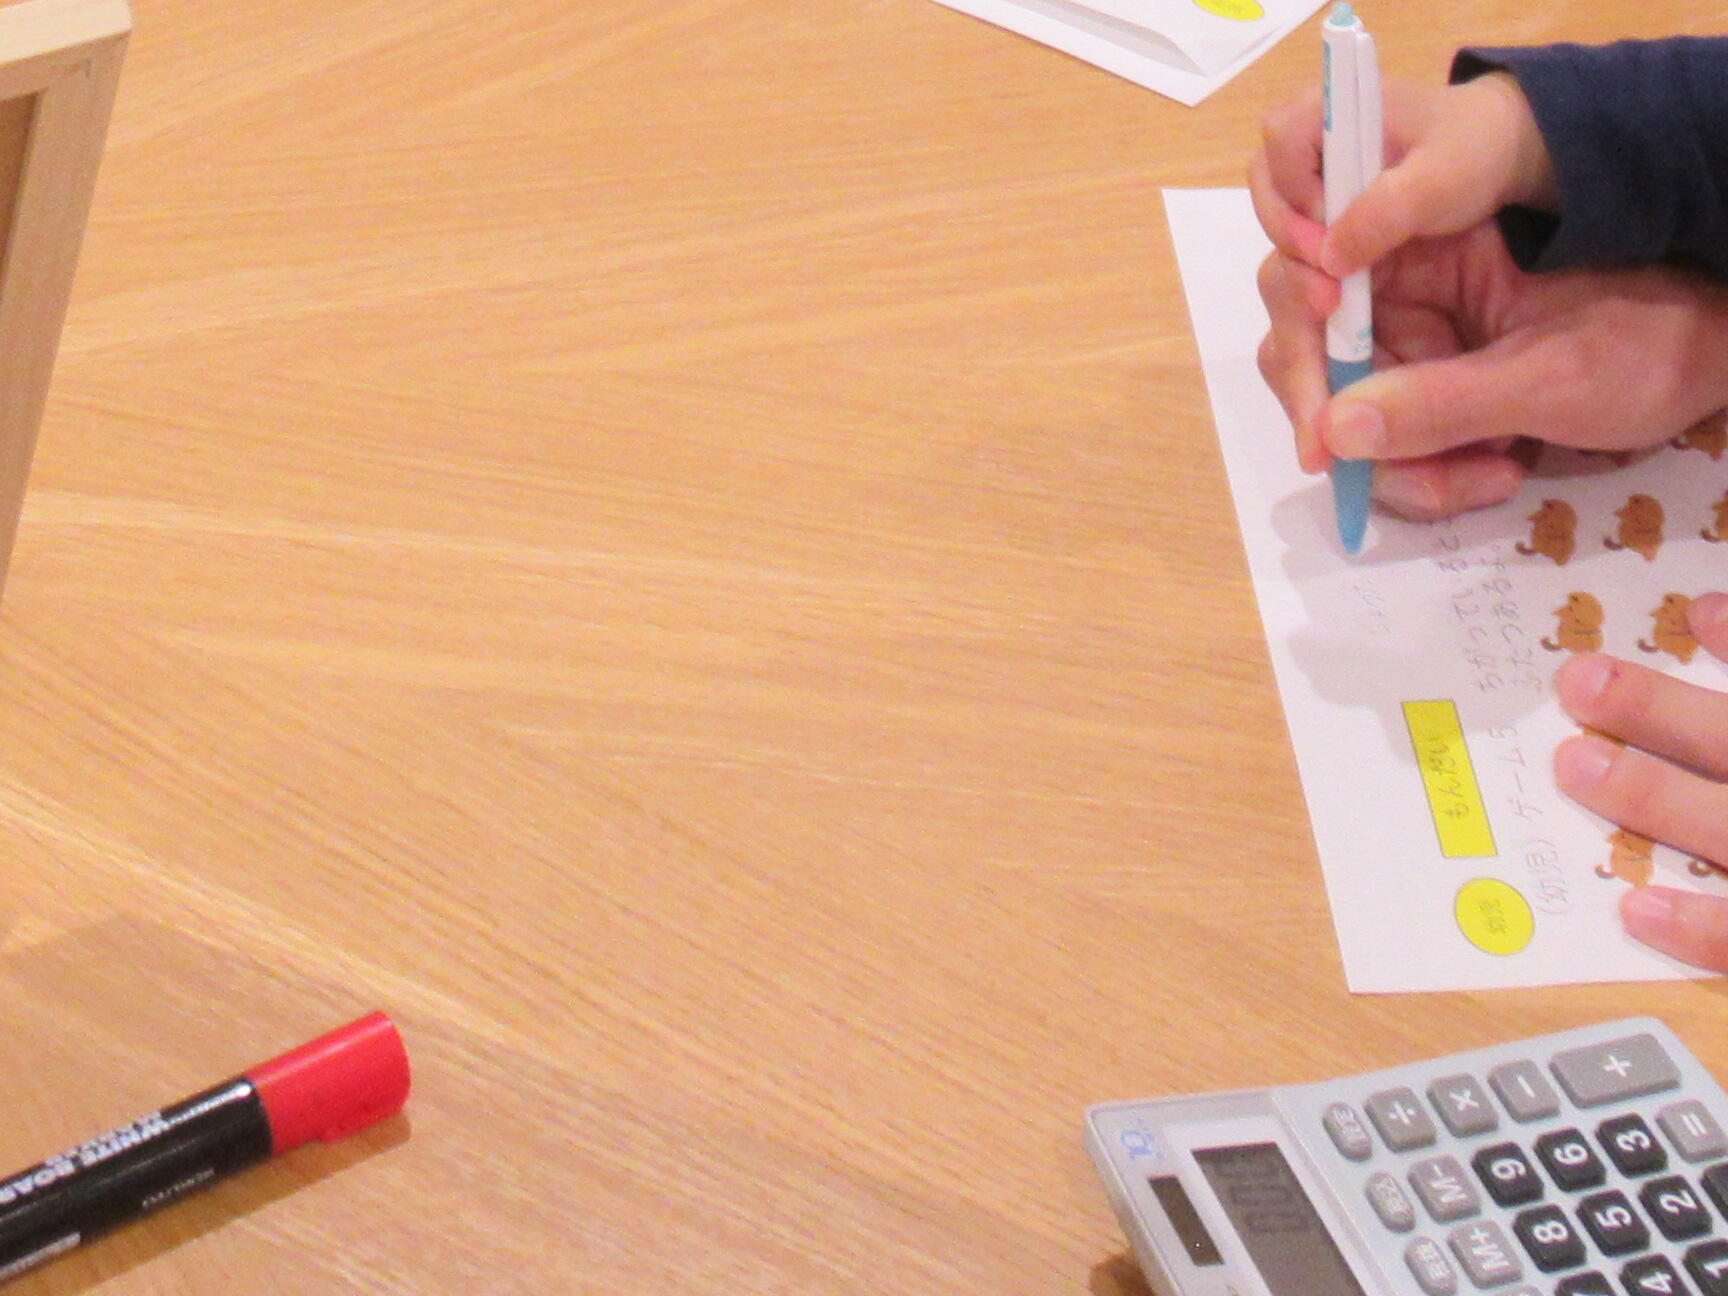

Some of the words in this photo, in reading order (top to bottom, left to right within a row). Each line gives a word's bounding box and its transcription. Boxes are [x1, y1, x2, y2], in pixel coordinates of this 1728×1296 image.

[1423, 733, 1470, 820] もんだい
[80, 1116, 168, 1167] WHITE
[1491, 1158, 1527, 1181] 9
[1553, 1141, 1589, 1166] 6
[1617, 1127, 1651, 1153] 3
[1533, 1220, 1569, 1245] 8
[1596, 1205, 1632, 1230] 5
[1659, 1188, 1694, 1216] 2
[1638, 1270, 1673, 1293] 4
